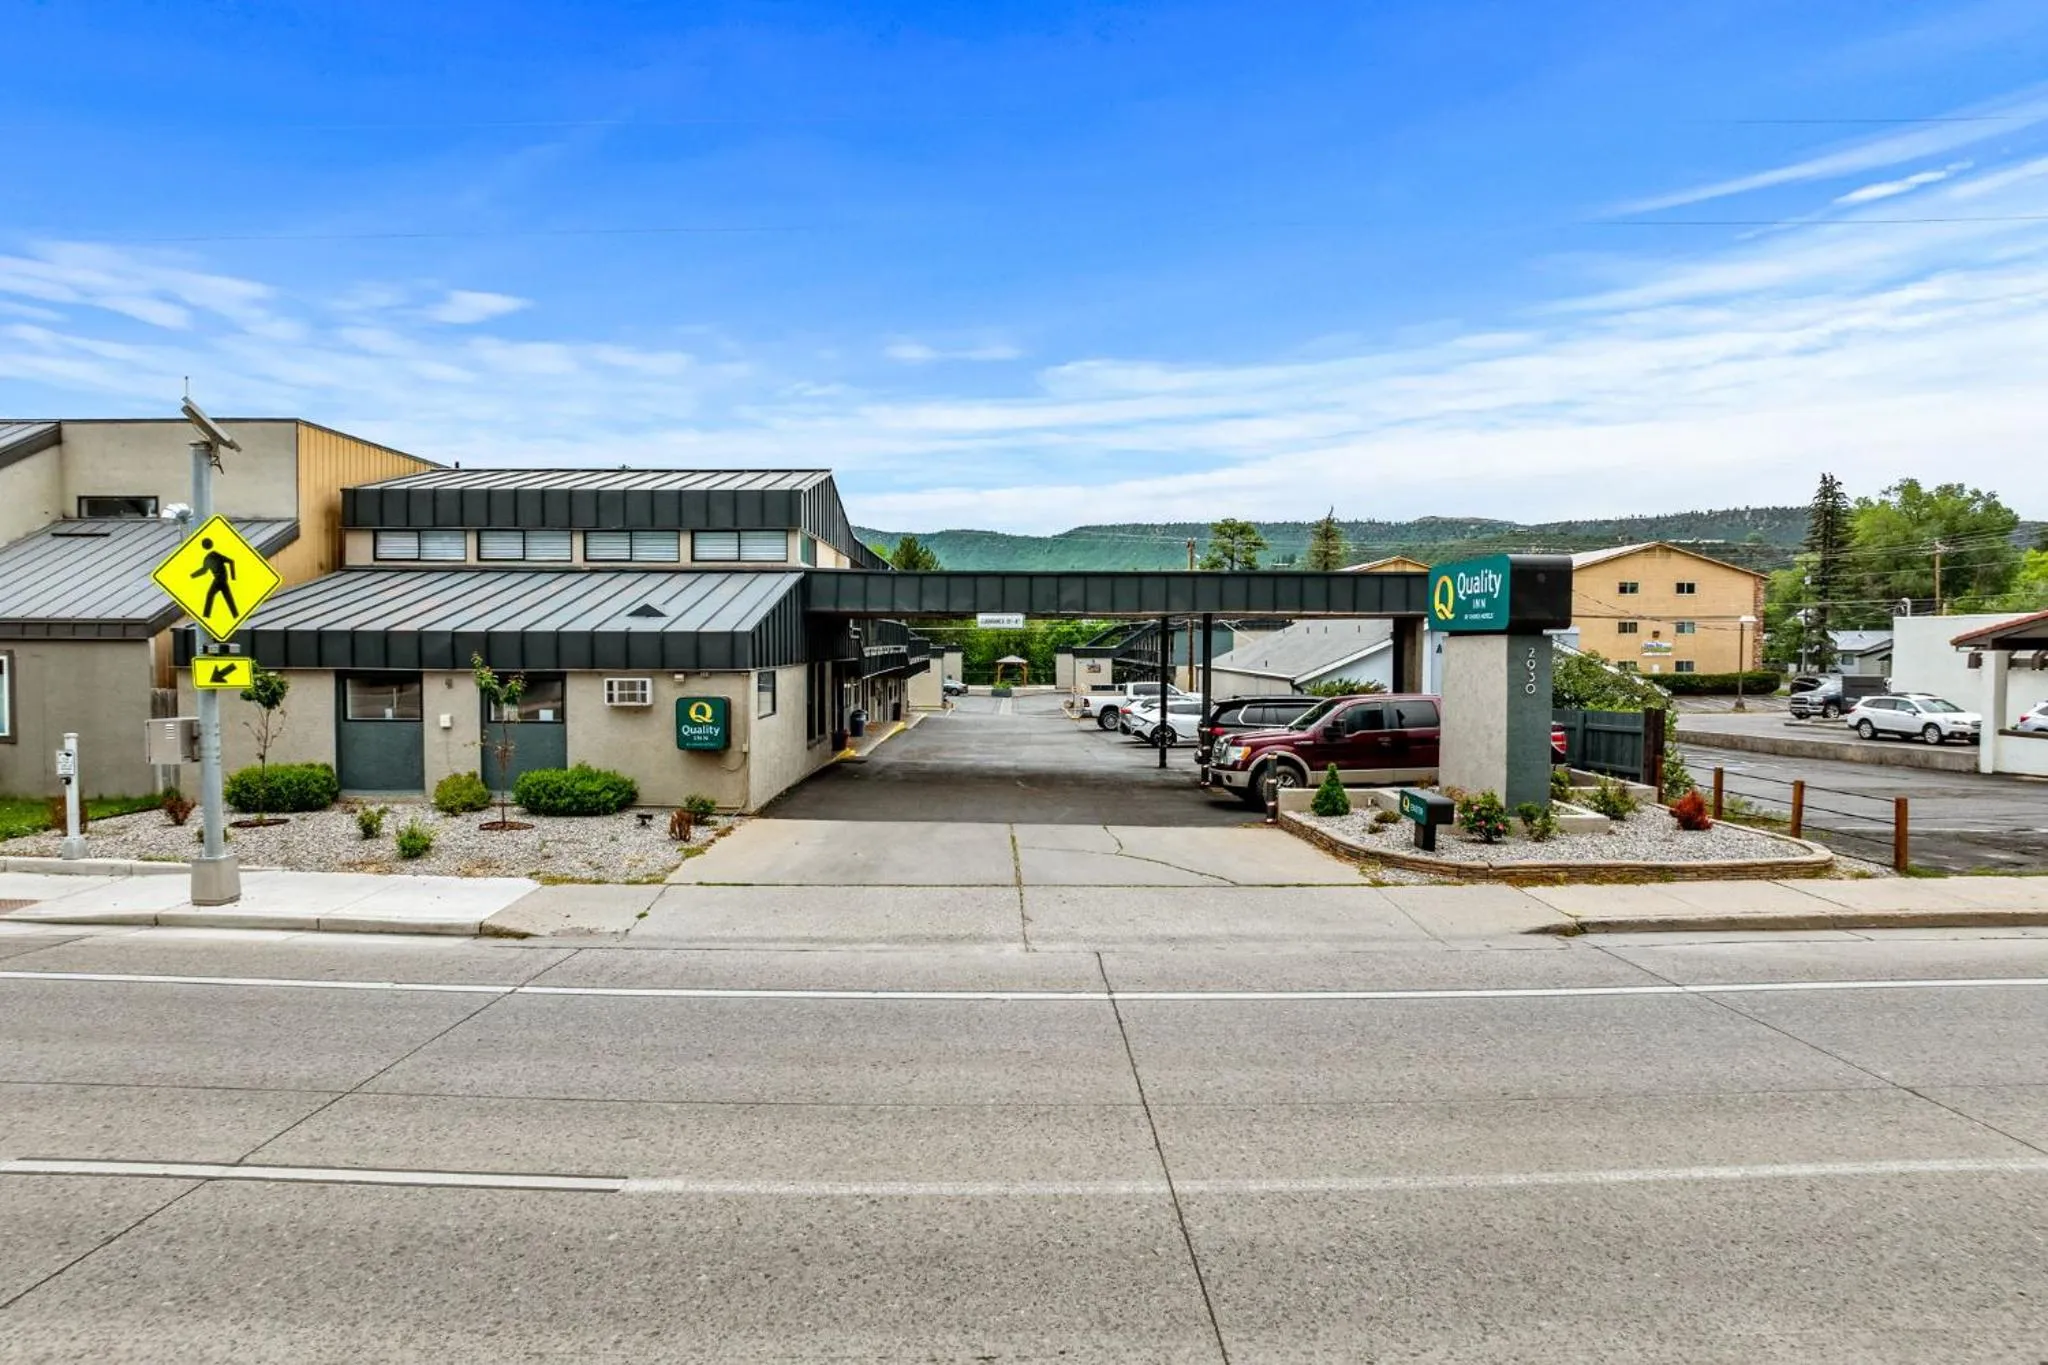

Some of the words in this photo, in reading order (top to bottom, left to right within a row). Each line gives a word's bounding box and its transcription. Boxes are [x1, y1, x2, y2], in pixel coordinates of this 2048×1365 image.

[1434, 575, 1455, 620] Q
[1457, 569, 1502, 600] Quality
[1472, 598, 1486, 609] INN
[1525, 647, 1537, 694] 2930
[689, 701, 714, 723] Q
[681, 724, 720, 737] Quality
